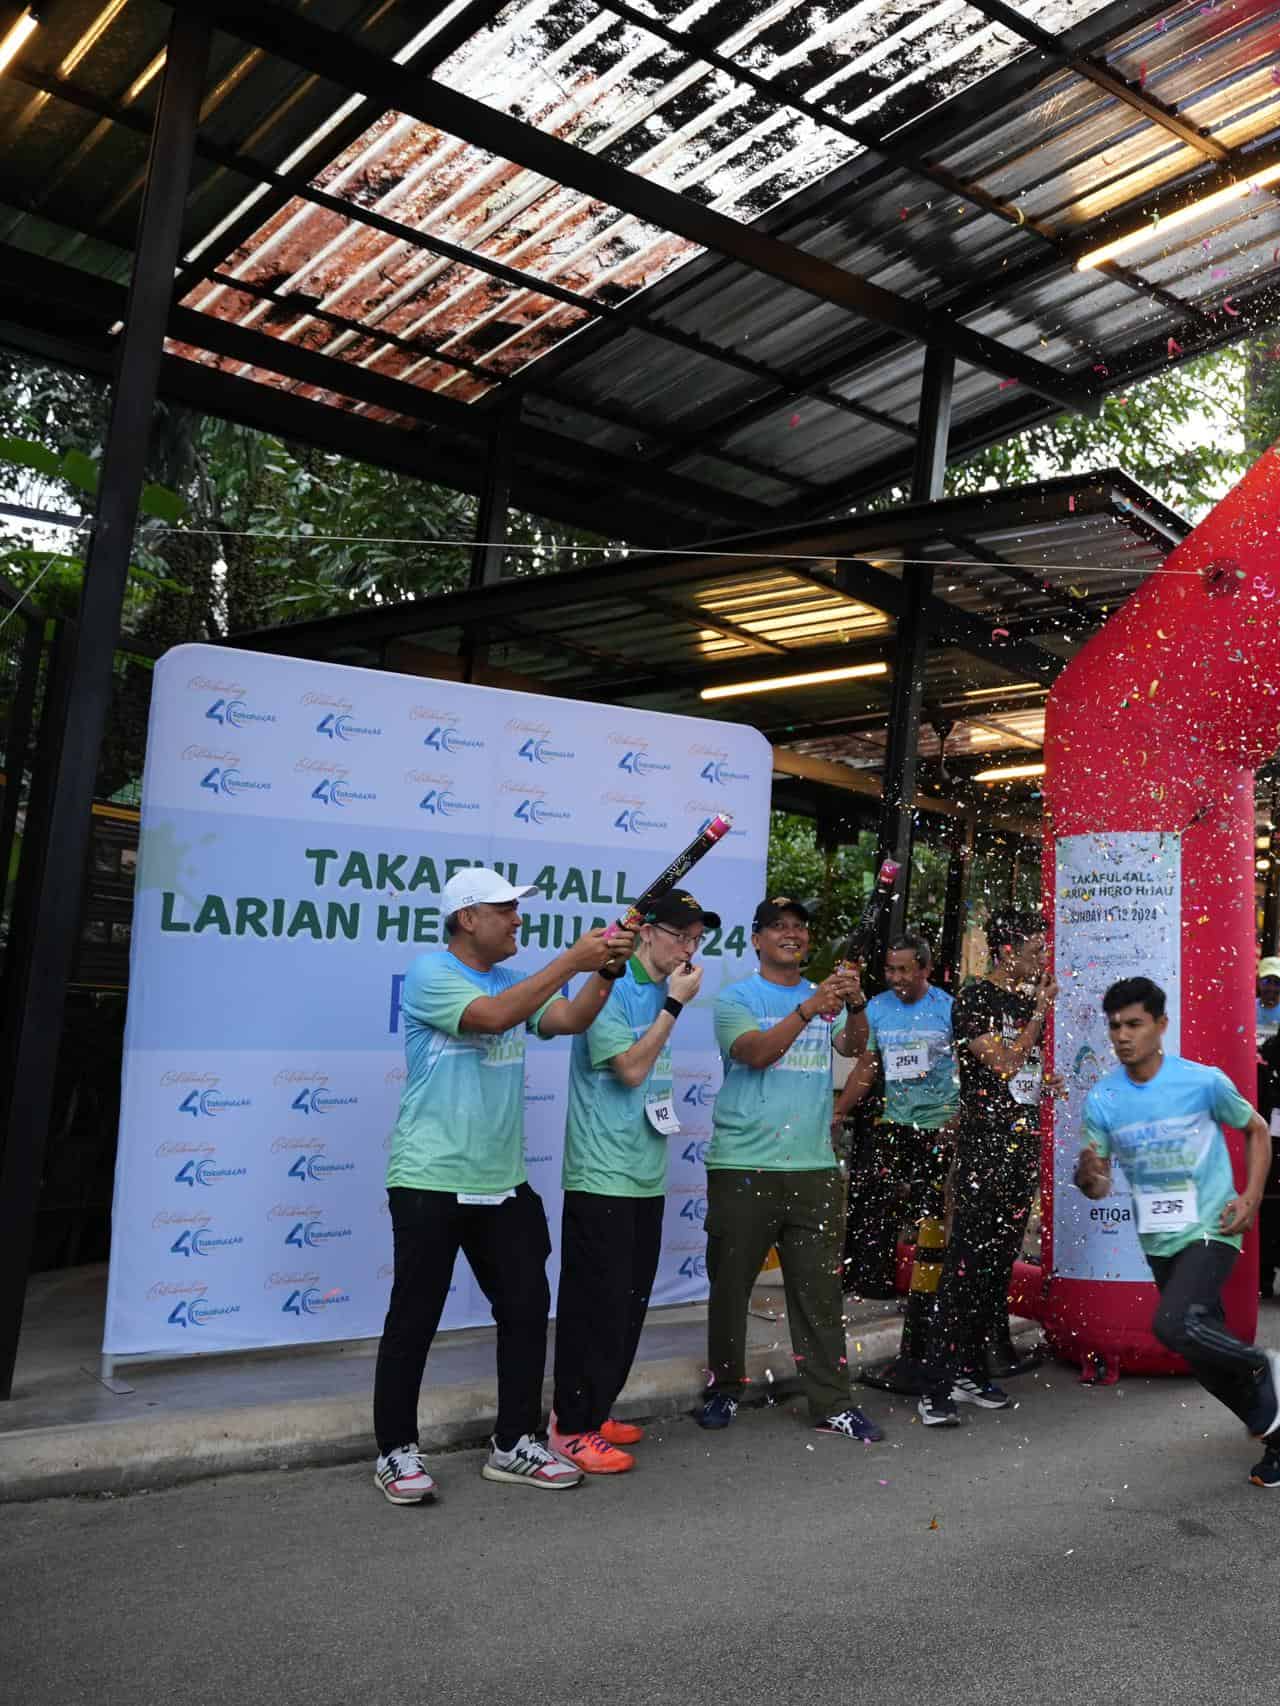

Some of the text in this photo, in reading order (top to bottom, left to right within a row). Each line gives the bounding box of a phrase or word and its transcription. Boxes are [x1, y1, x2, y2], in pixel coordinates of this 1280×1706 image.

[305, 848, 636, 905] TAKAF4ALL
[160, 891, 360, 940] LARIAN
[1089, 1197, 1131, 1222] eTiQa
